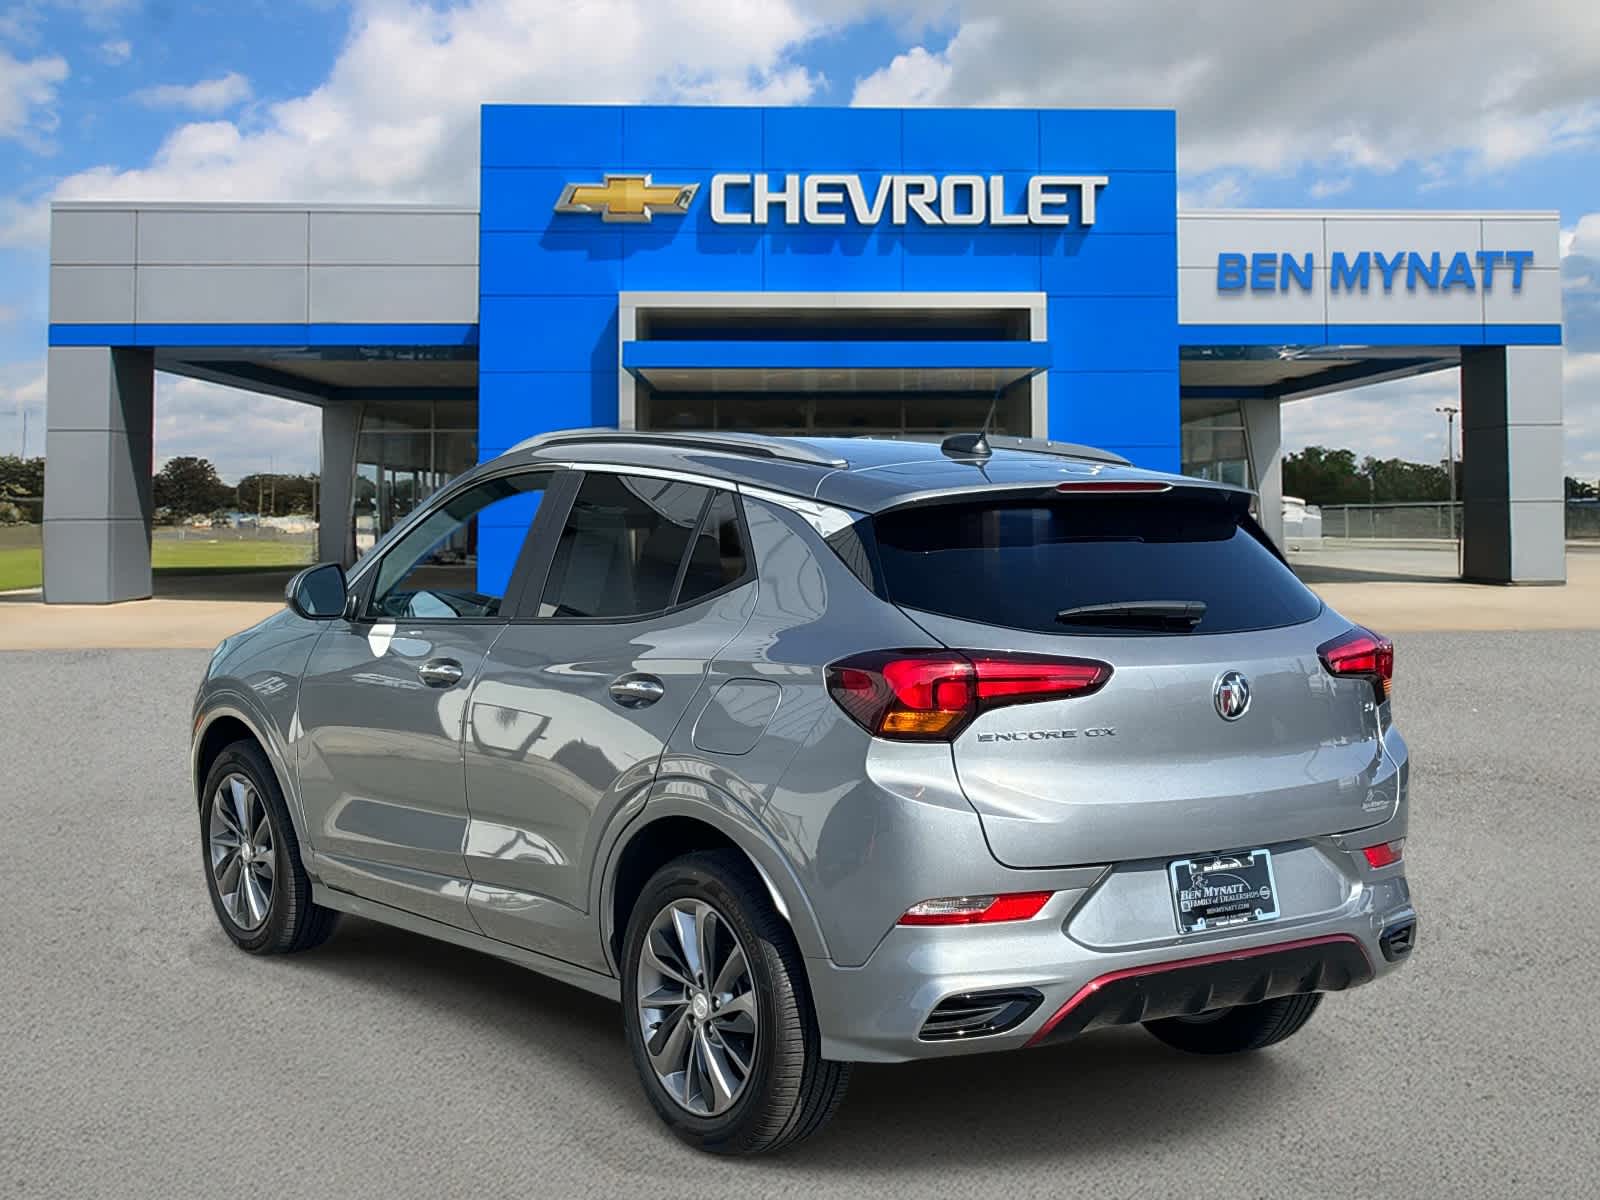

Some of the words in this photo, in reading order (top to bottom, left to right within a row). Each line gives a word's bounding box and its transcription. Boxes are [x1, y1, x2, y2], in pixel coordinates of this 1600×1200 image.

[711, 174, 1109, 225] CHEVROLET
[1217, 252, 1313, 292] BEN
[1330, 250, 1534, 292] MYNATT
[977, 728, 1078, 743] ENCORE
[1084, 727, 1117, 738] GX
[1180, 888, 1202, 900] BEN
[1203, 883, 1246, 898] MYNATT
